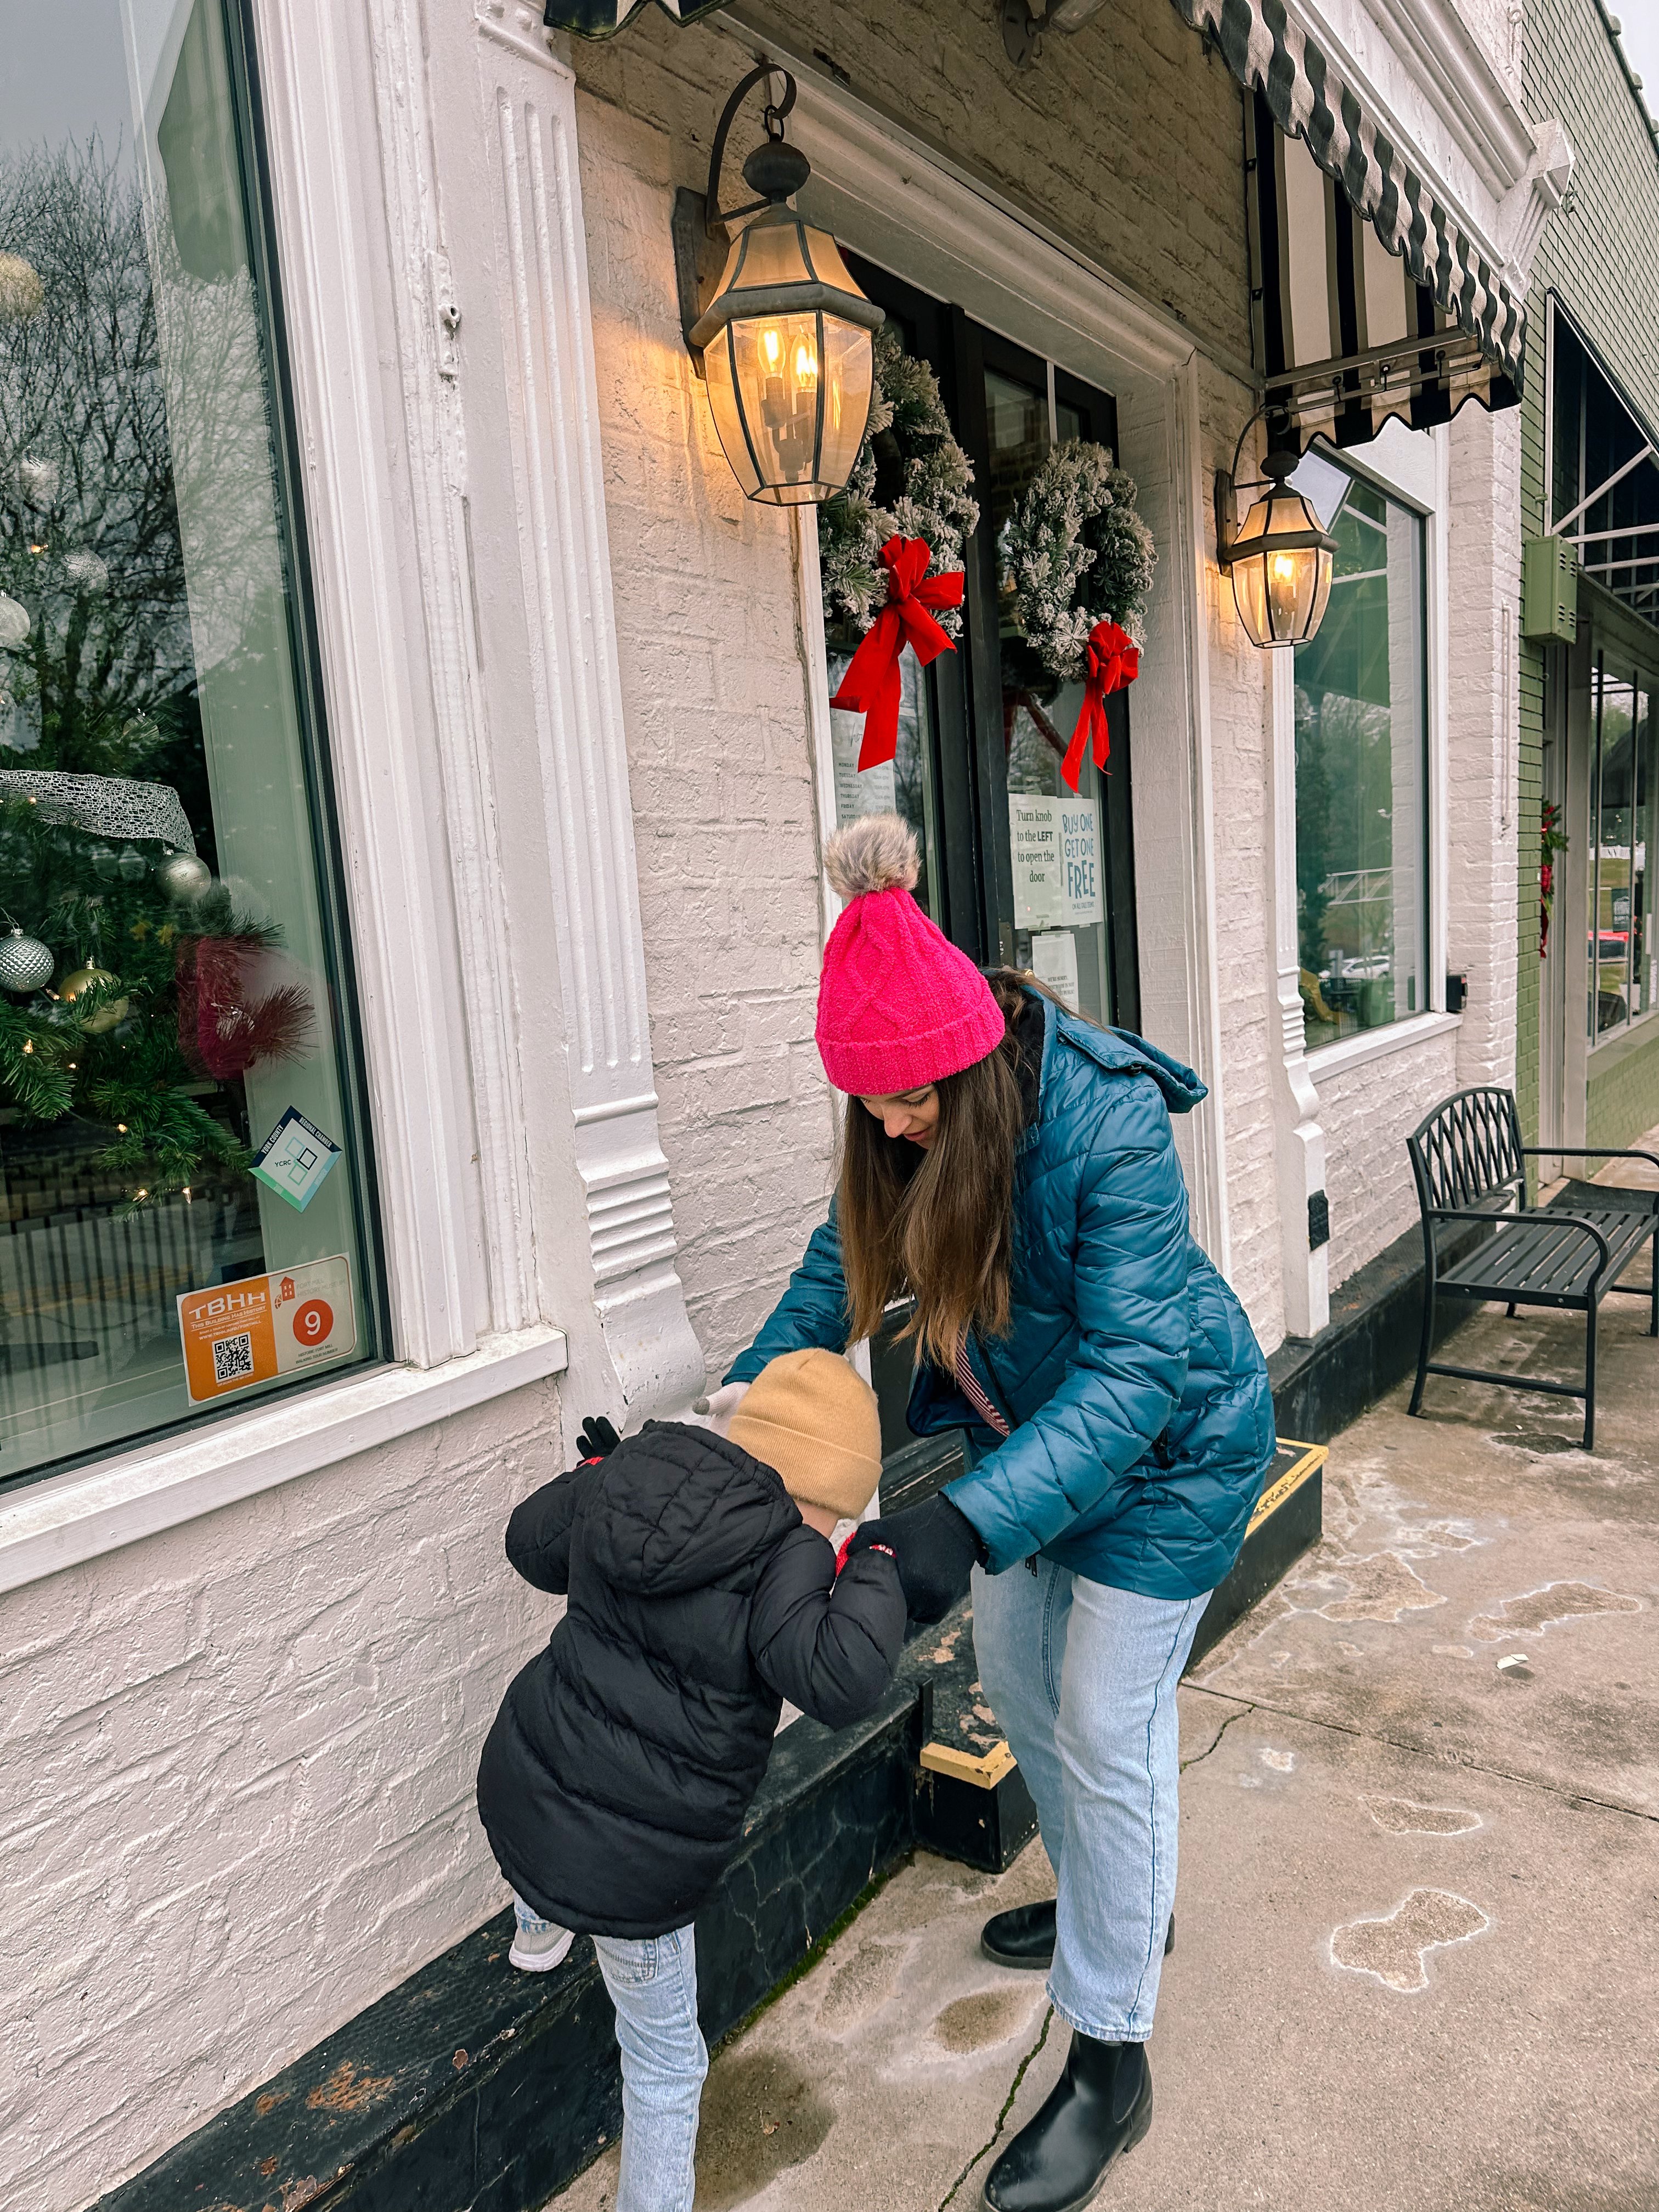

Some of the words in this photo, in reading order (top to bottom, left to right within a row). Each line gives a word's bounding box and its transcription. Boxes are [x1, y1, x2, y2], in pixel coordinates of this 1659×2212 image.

[1017, 809, 1034, 821] Turn
[1035, 809, 1052, 822] knob
[1062, 814, 1078, 835] BUY
[1080, 813, 1093, 832] ONE
[1017, 831, 1024, 842] to
[1025, 830, 1036, 842] the
[1037, 831, 1053, 842] LEFT
[1018, 851, 1024, 862] to
[1026, 853, 1042, 865] open
[1043, 850, 1054, 862] the
[1065, 838, 1079, 858] GET
[1080, 838, 1093, 856] ONE
[1030, 870, 1045, 882] door
[1068, 860, 1095, 899] FREE
[261, 1138, 273, 1154] YORK
[270, 1125, 284, 1143] COUNTY
[299, 1117, 315, 1135] REGIONAL
[315, 1131, 332, 1148] CHAMBER
[189, 1292, 266, 1319] TBHH
[305, 1311, 320, 1335] 9
